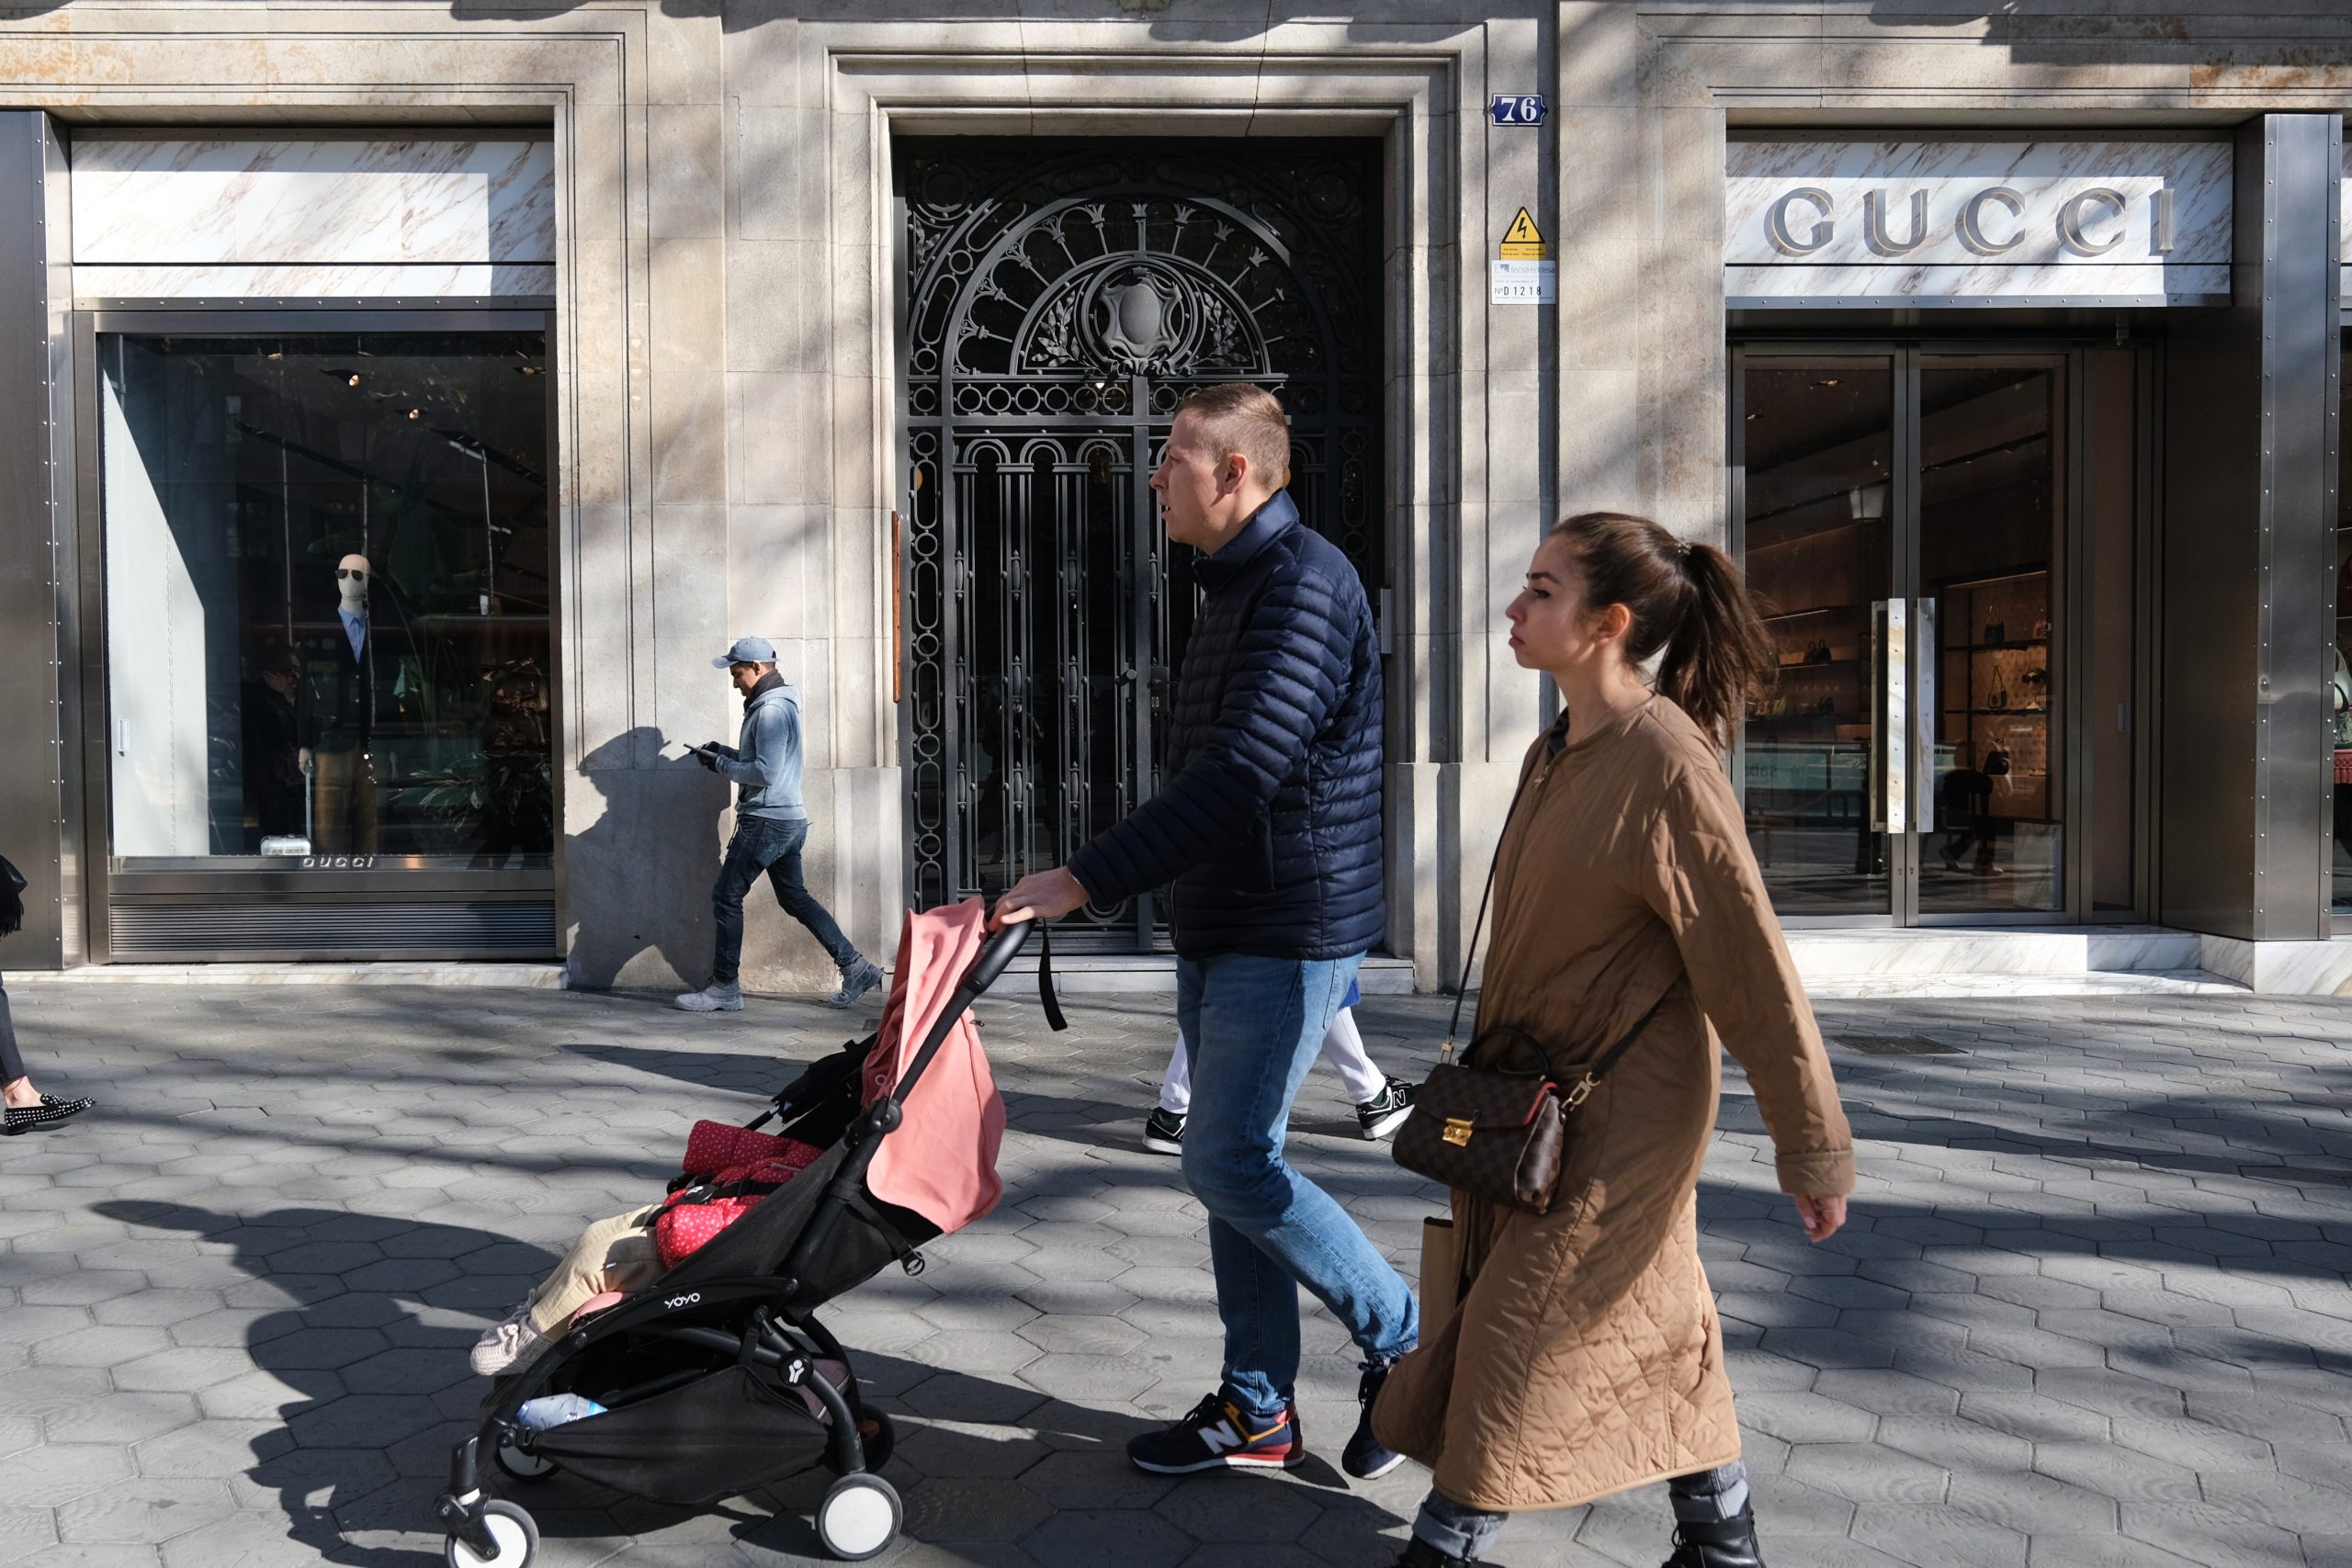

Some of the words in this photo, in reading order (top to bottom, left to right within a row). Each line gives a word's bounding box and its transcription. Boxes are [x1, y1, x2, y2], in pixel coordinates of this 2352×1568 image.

[1500, 96, 1537, 122] 76
[1768, 186, 2176, 255] GUCCI
[302, 857, 374, 868] GUCCI
[1393, 1089, 1406, 1109] N
[1197, 1419, 1242, 1455] N
